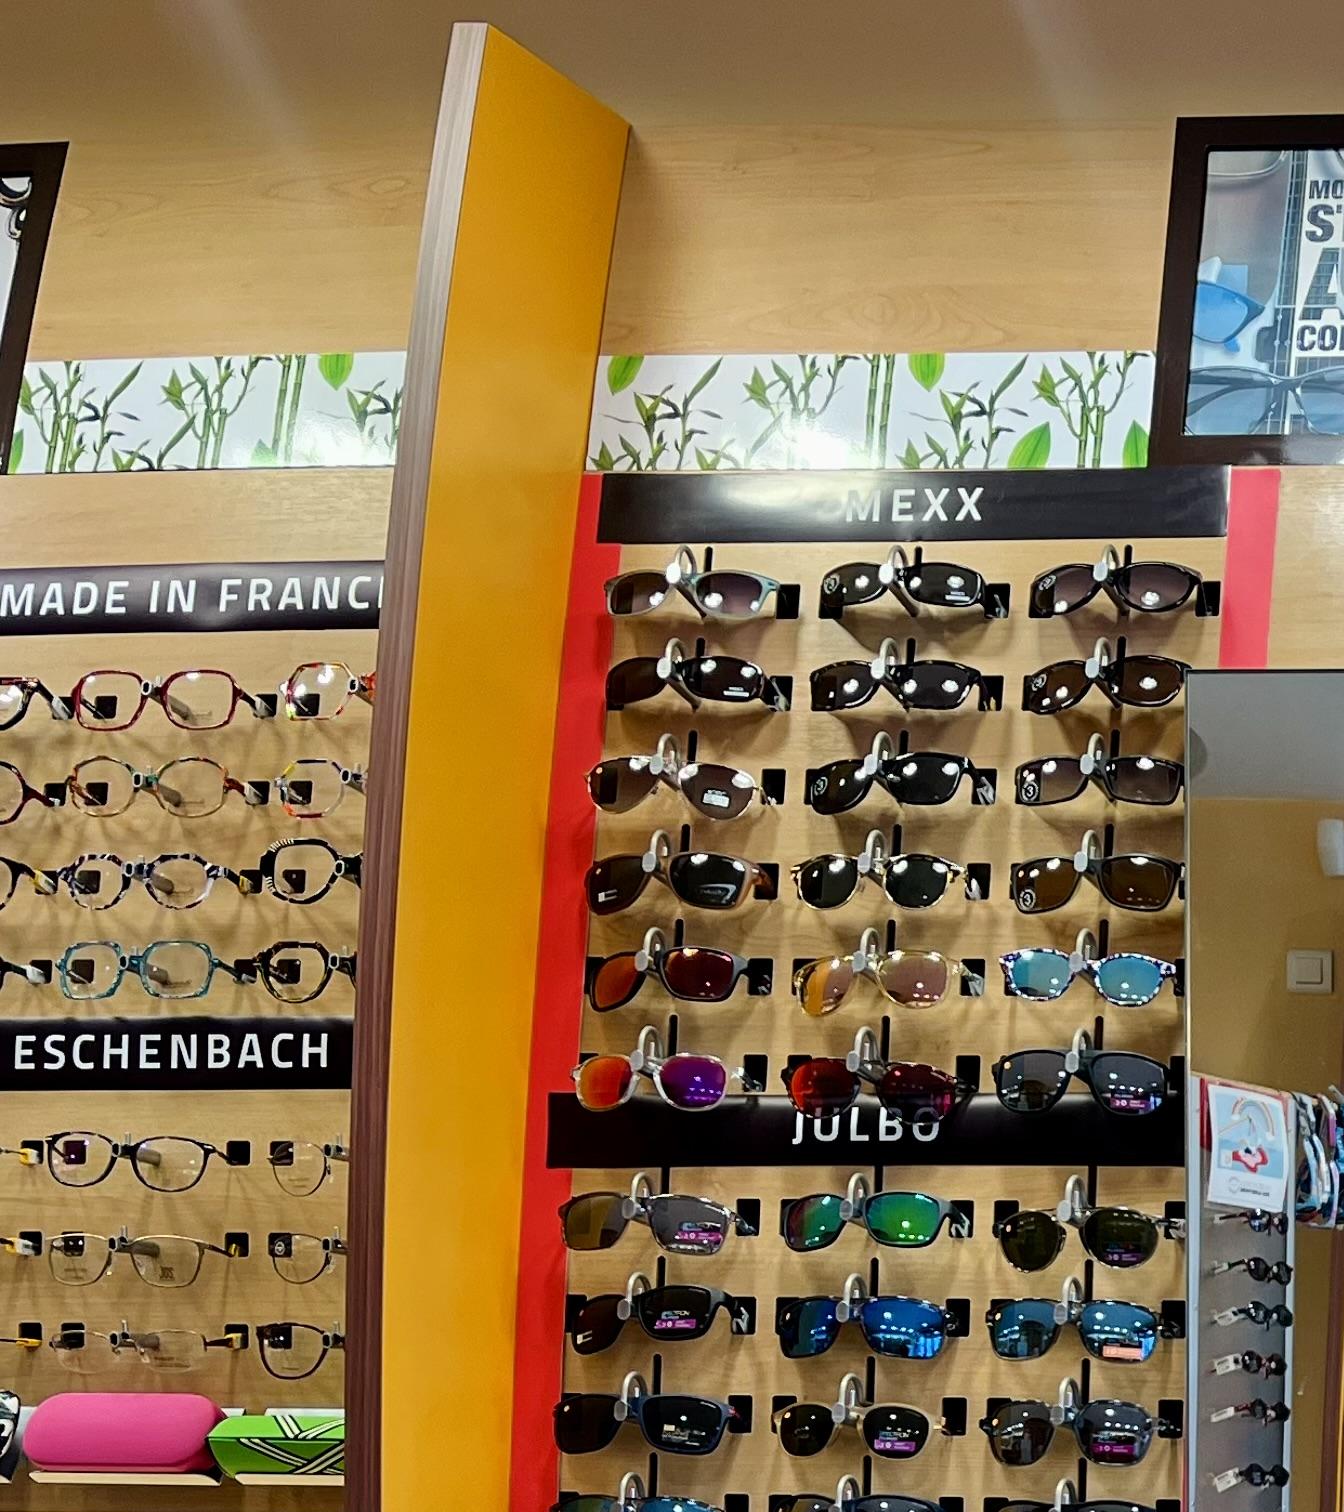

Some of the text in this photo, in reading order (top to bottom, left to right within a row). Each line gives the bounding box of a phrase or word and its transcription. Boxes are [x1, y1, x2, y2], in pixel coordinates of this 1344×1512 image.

[845, 486, 985, 523] MEXX
[0, 574, 384, 617] MADE IN FRANC
[13, 1032, 329, 1071] ESCHENBACH
[791, 1106, 941, 1145] JULBO
